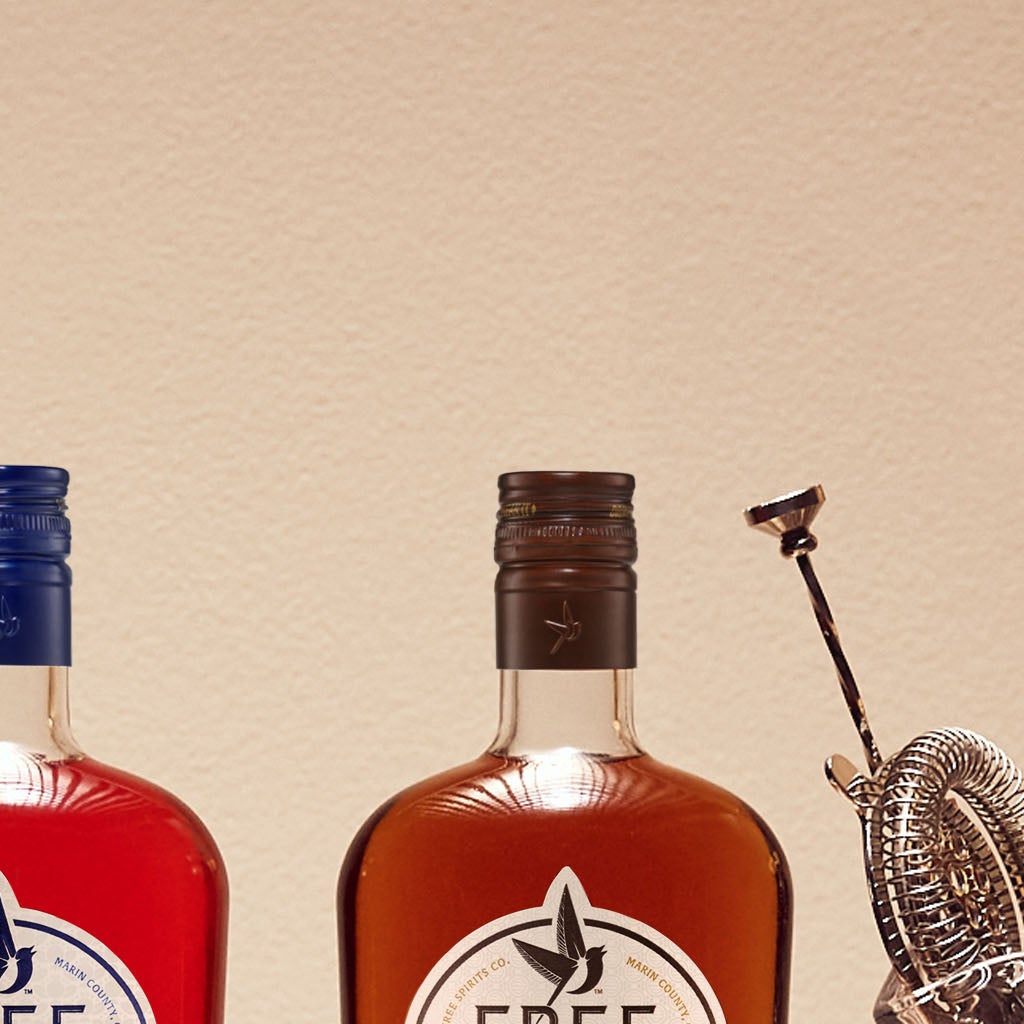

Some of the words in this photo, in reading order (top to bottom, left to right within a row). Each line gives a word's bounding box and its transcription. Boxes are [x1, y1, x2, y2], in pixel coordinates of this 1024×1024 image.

[54, 957, 87, 981] MARIN
[454, 968, 490, 1002] SPIRITS
[490, 958, 511, 972] CO.
[625, 956, 660, 982] MARIN
